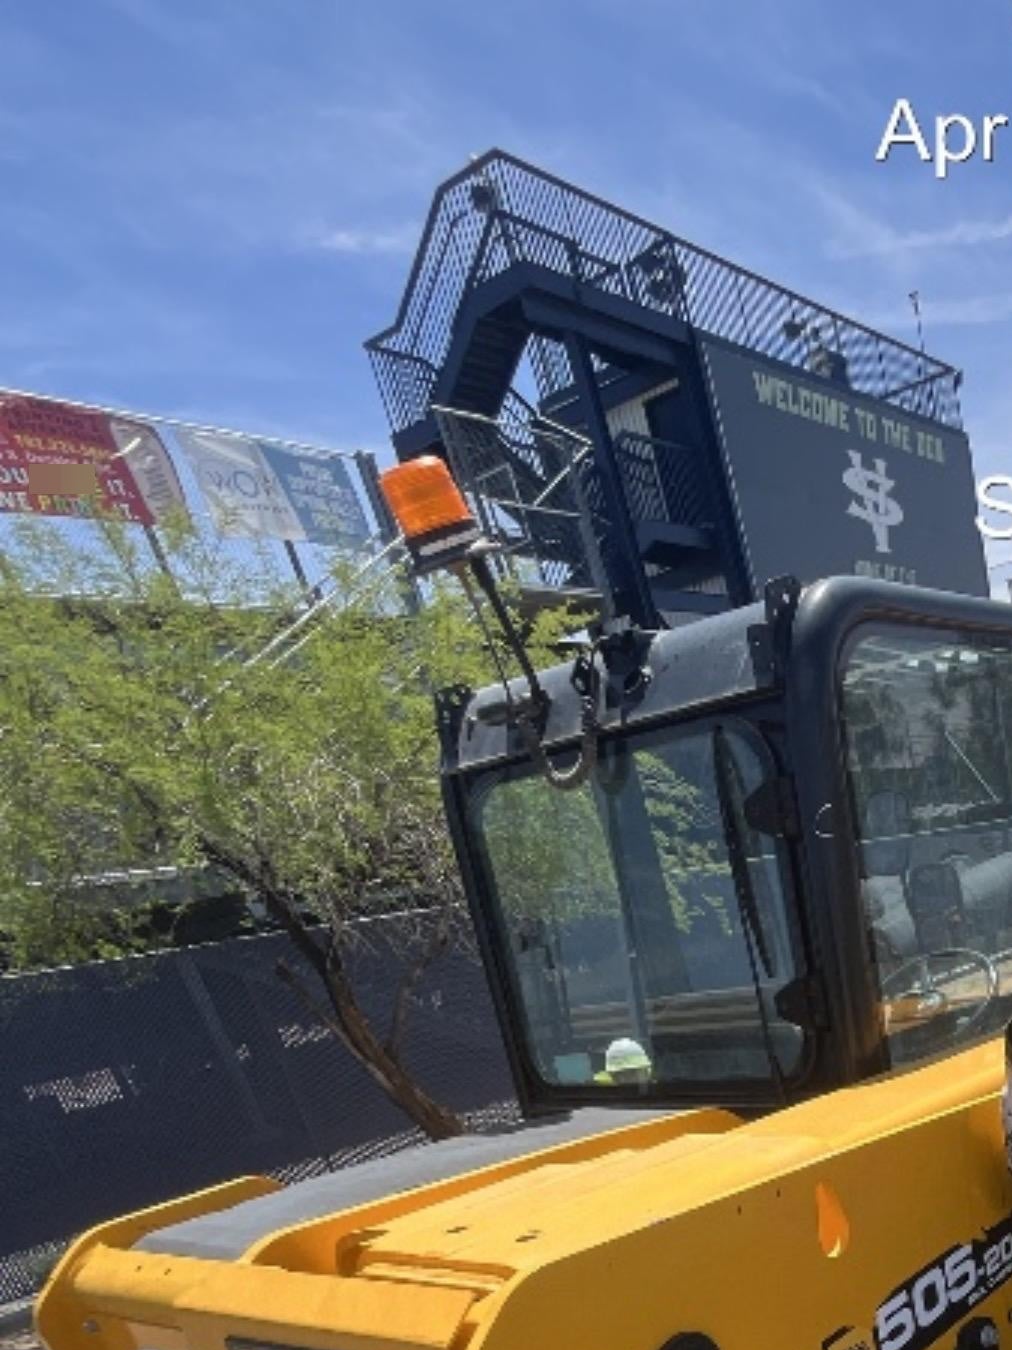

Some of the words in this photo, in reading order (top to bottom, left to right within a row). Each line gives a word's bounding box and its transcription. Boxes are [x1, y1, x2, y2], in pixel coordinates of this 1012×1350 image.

[753, 371, 849, 432] WELCOME
[855, 407, 877, 442] TO
[882, 417, 912, 454] THE
